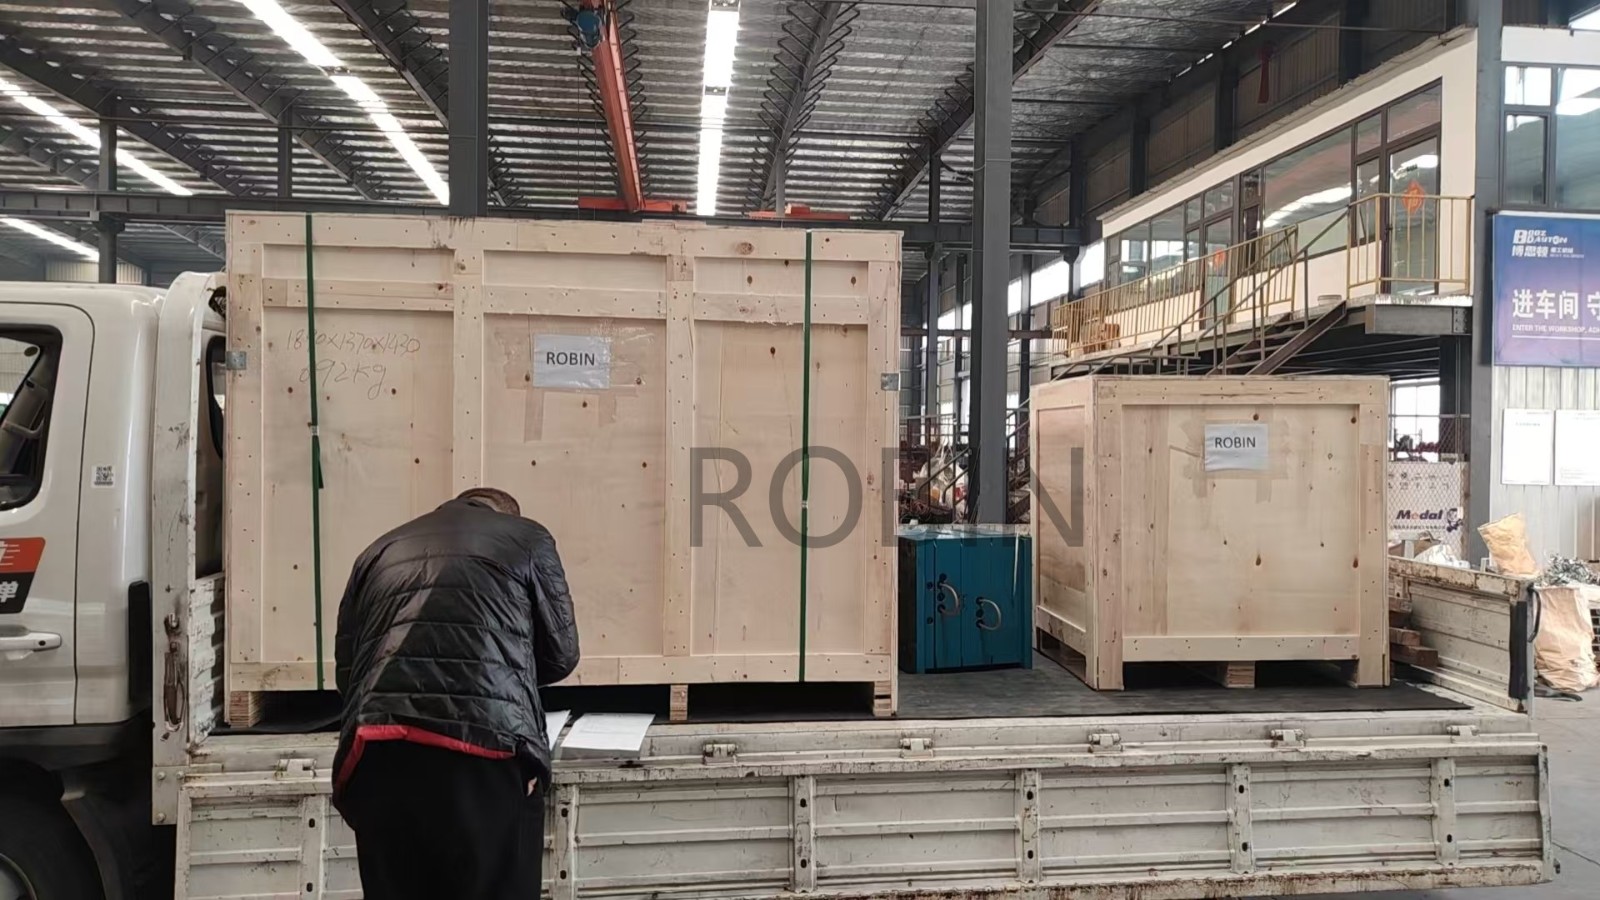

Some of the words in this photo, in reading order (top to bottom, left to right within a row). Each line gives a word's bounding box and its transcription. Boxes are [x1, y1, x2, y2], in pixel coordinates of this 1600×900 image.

[1512, 289, 1579, 320] 进车间
[1512, 324, 1534, 332] ENTER
[546, 351, 595, 366] ROBIN
[1215, 436, 1256, 448] ROBIN
